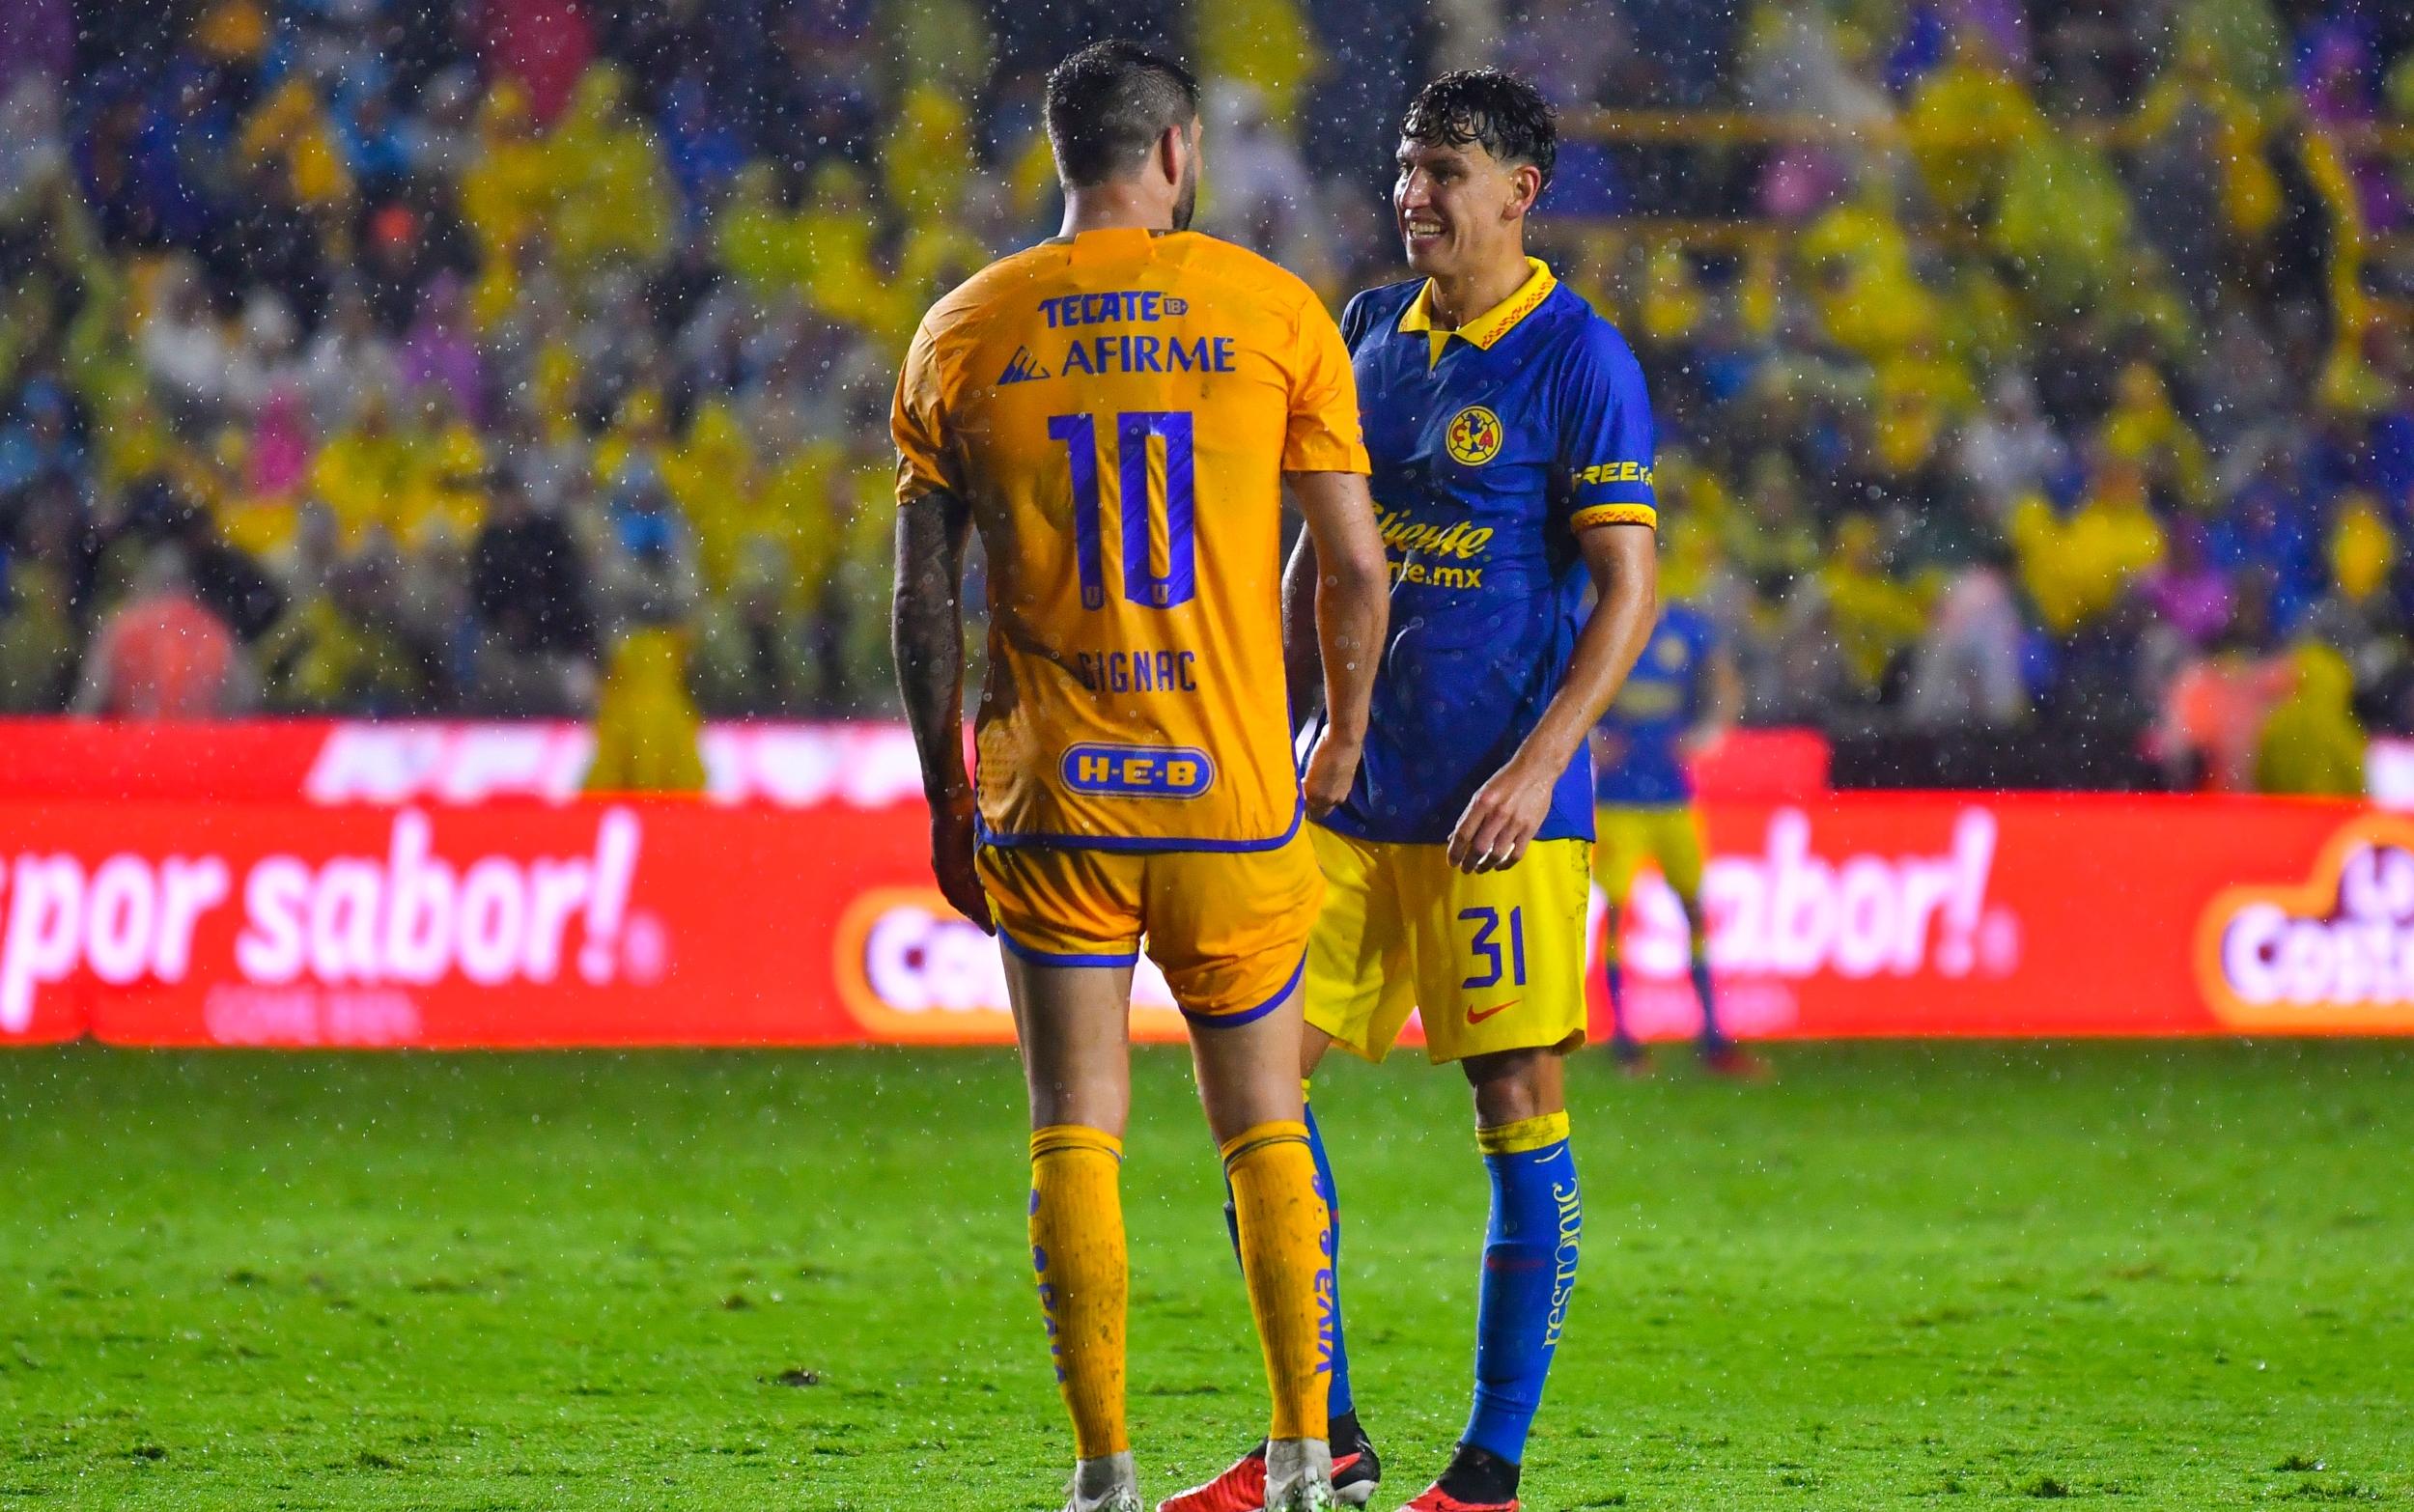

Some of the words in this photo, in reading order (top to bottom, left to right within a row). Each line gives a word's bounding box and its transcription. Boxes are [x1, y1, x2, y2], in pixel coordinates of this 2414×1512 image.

[1037, 291, 1165, 328] TECATE
[1061, 335, 1235, 377] AFIRME
[1048, 410, 1196, 611] 10
[1078, 755, 1197, 786] H-E-B
[0, 854, 229, 1033] por
[236, 807, 641, 986] sabor!
[1457, 906, 1527, 990] 31
